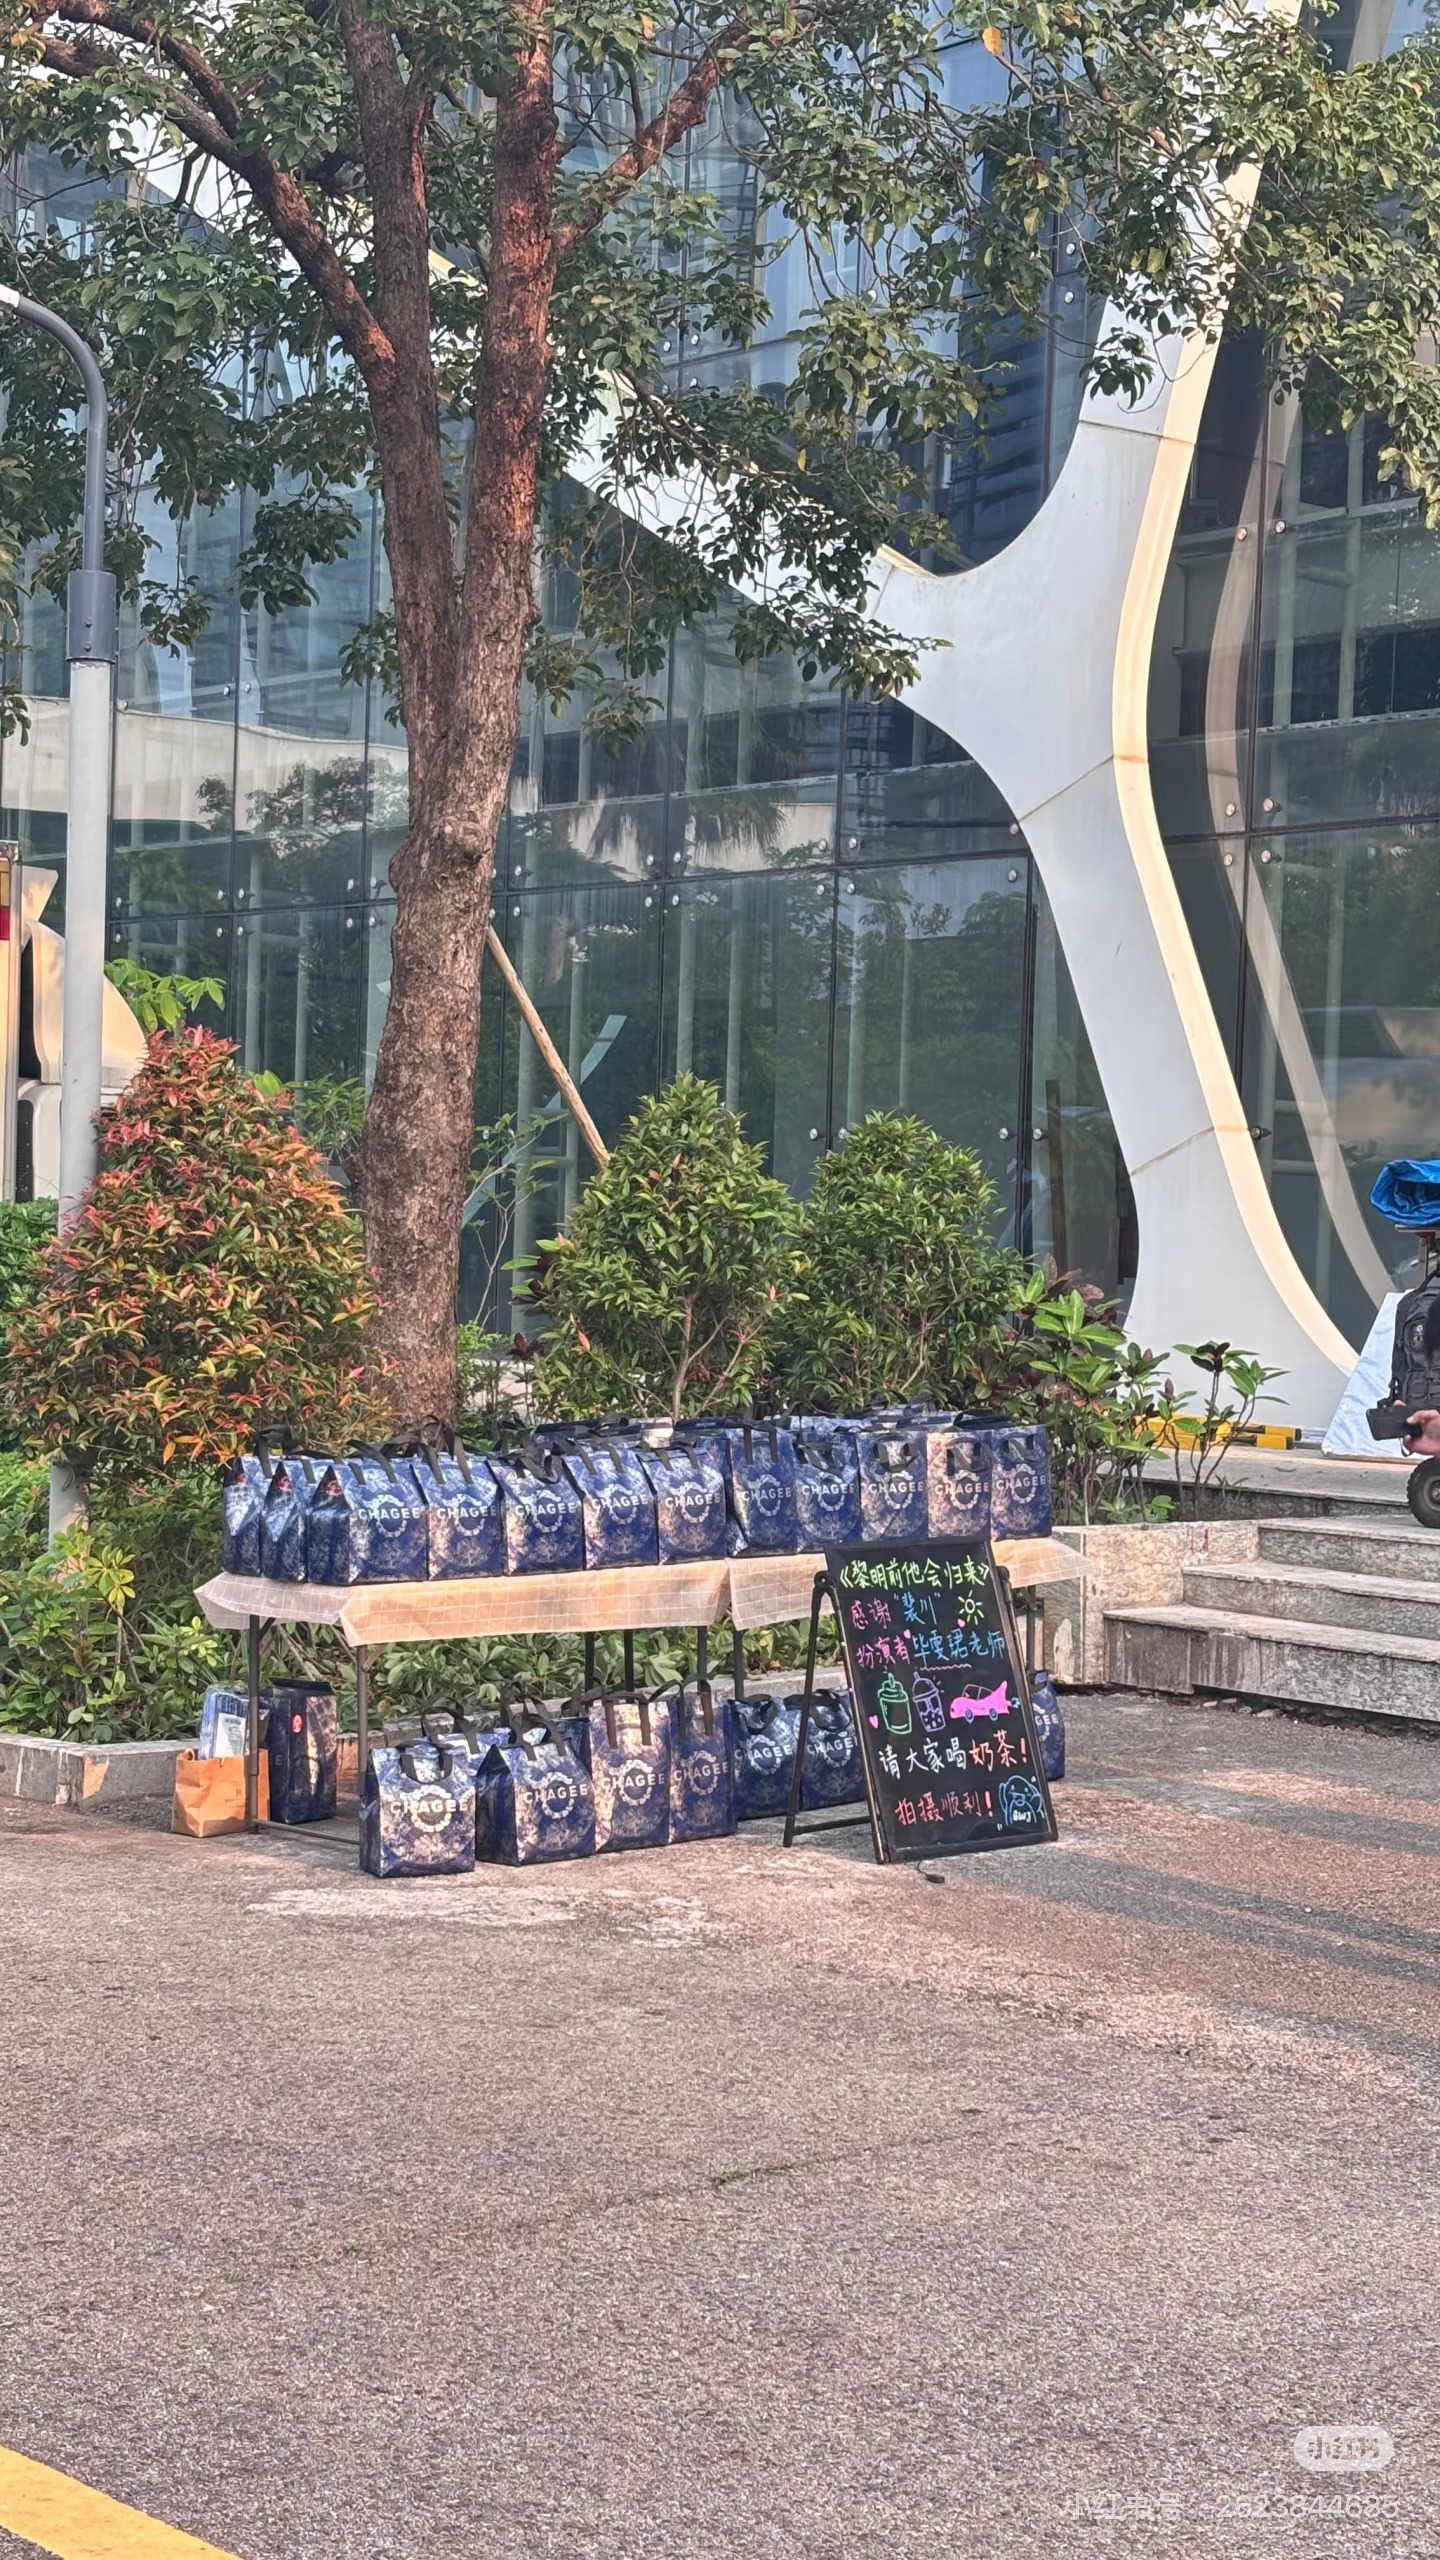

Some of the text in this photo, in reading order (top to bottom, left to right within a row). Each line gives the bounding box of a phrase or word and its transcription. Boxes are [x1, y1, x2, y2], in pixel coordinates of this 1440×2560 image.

[801, 1483, 855, 1496] CHAGEE
[868, 1481, 924, 1495] CHAGEE
[934, 1481, 989, 1496] CHAGEE
[996, 1475, 1047, 1490] CHAGEE
[592, 1494, 648, 1509] CHAGEE
[665, 1493, 721, 1508] CHAGEE
[742, 1487, 792, 1501] CHAGEE
[358, 1507, 420, 1520] CHAGEE
[437, 1505, 497, 1519] CHAGEE
[515, 1502, 576, 1517] CHAGEE
[840, 1555, 990, 1590] 《黎明前他会归来》
[1034, 1713, 1059, 1726] GEE
[806, 1735, 858, 1755] CHAGE
[673, 1762, 729, 1781] CHAGEE
[601, 1773, 665, 1789] CHAGEE
[525, 1784, 588, 1804] CHAGEE
[390, 1799, 468, 1814] CHAGEE
[894, 1790, 994, 1826] 拍摄顺利！
